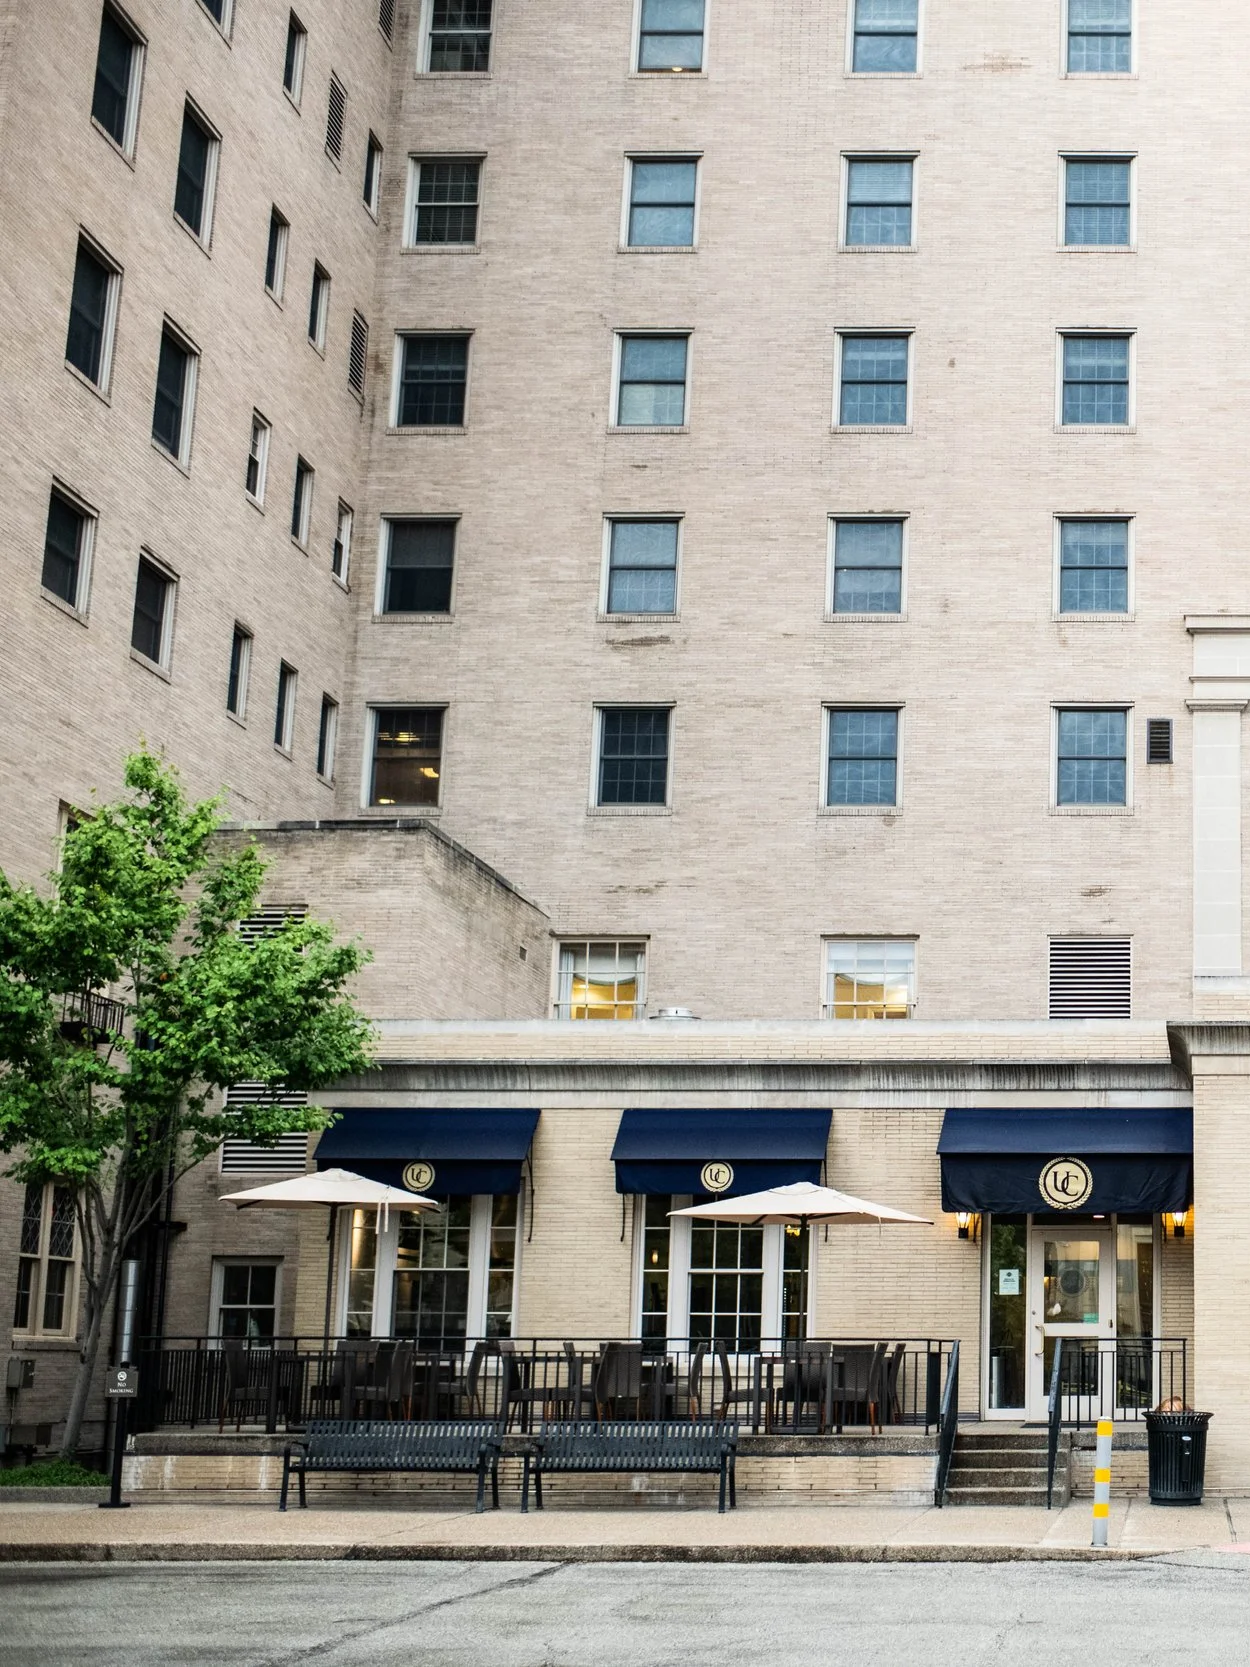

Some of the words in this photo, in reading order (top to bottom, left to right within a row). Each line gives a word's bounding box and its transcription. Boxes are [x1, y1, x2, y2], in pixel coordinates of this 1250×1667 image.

[411, 1167, 427, 1184] UC
[710, 1168, 725, 1184] UC
[1053, 1170, 1079, 1197] UC
